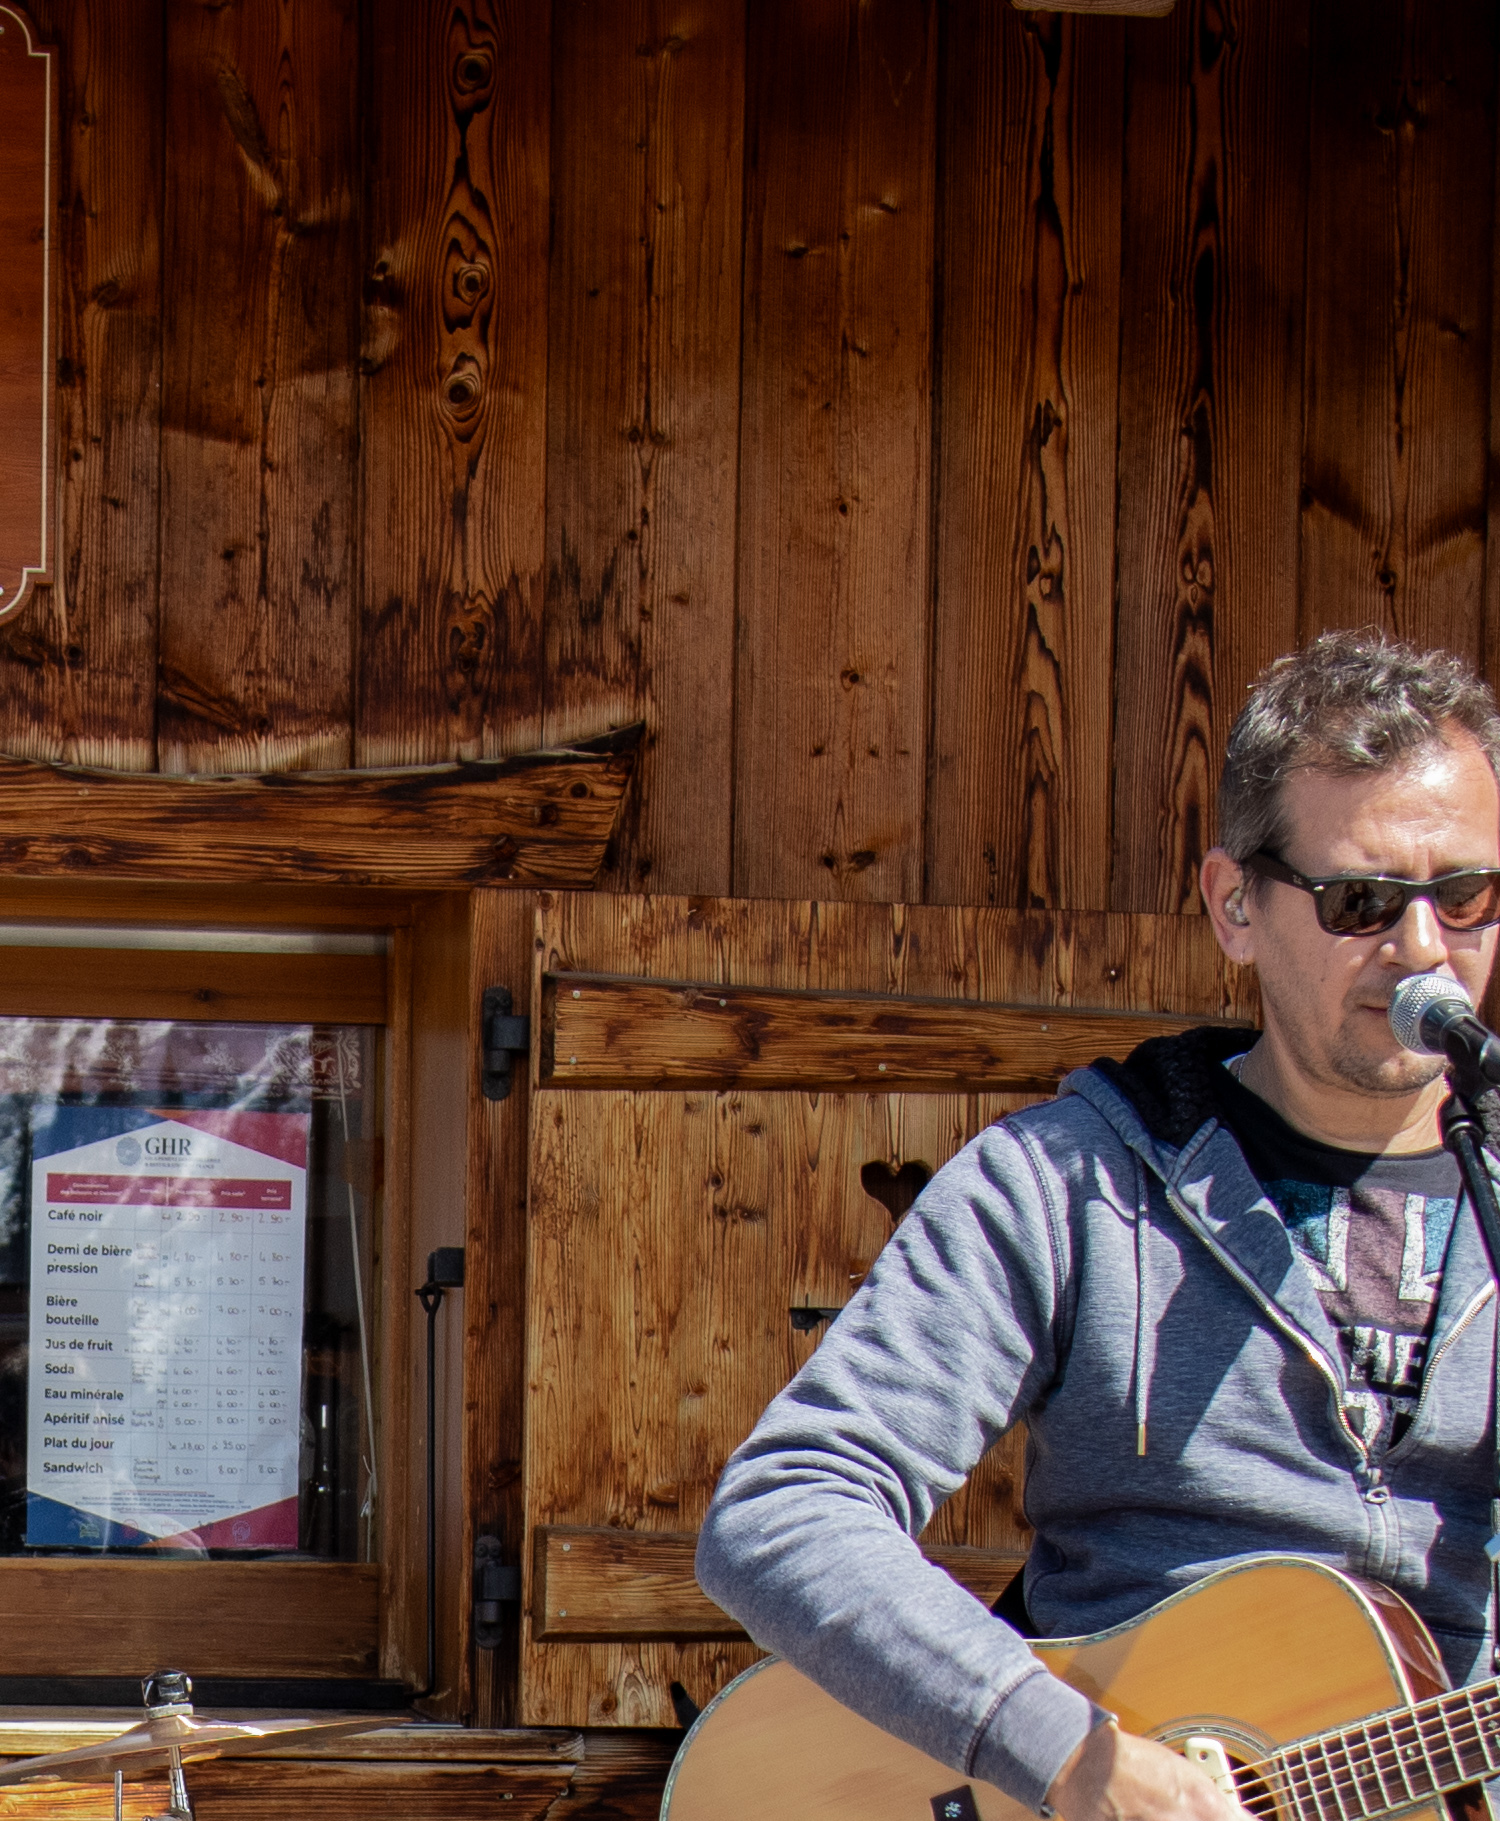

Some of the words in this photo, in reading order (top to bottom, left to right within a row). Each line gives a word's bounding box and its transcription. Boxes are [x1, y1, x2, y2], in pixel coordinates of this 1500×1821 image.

[144, 1137, 191, 1155] GHR
[47, 1209, 76, 1222] Café
[79, 1211, 103, 1222] noir
[47, 1243, 80, 1255] Demi
[84, 1244, 98, 1255] de
[101, 1244, 132, 1257] bière
[47, 1262, 98, 1275] pression
[46, 1295, 78, 1308] Bière
[46, 1313, 99, 1327] bouteille
[45, 1338, 62, 1350] Jus
[65, 1338, 82, 1351] de
[86, 1338, 114, 1352] fruit
[45, 1363, 75, 1375] Soda
[44, 1387, 67, 1399] Eau
[71, 1387, 124, 1401] minérale
[44, 1412, 89, 1427] Apéritif
[93, 1413, 125, 1427] anisé
[44, 1437, 67, 1449] Plat
[71, 1438, 85, 1449] du
[88, 1438, 114, 1452] jour
[44, 1461, 104, 1474] Sandwich
